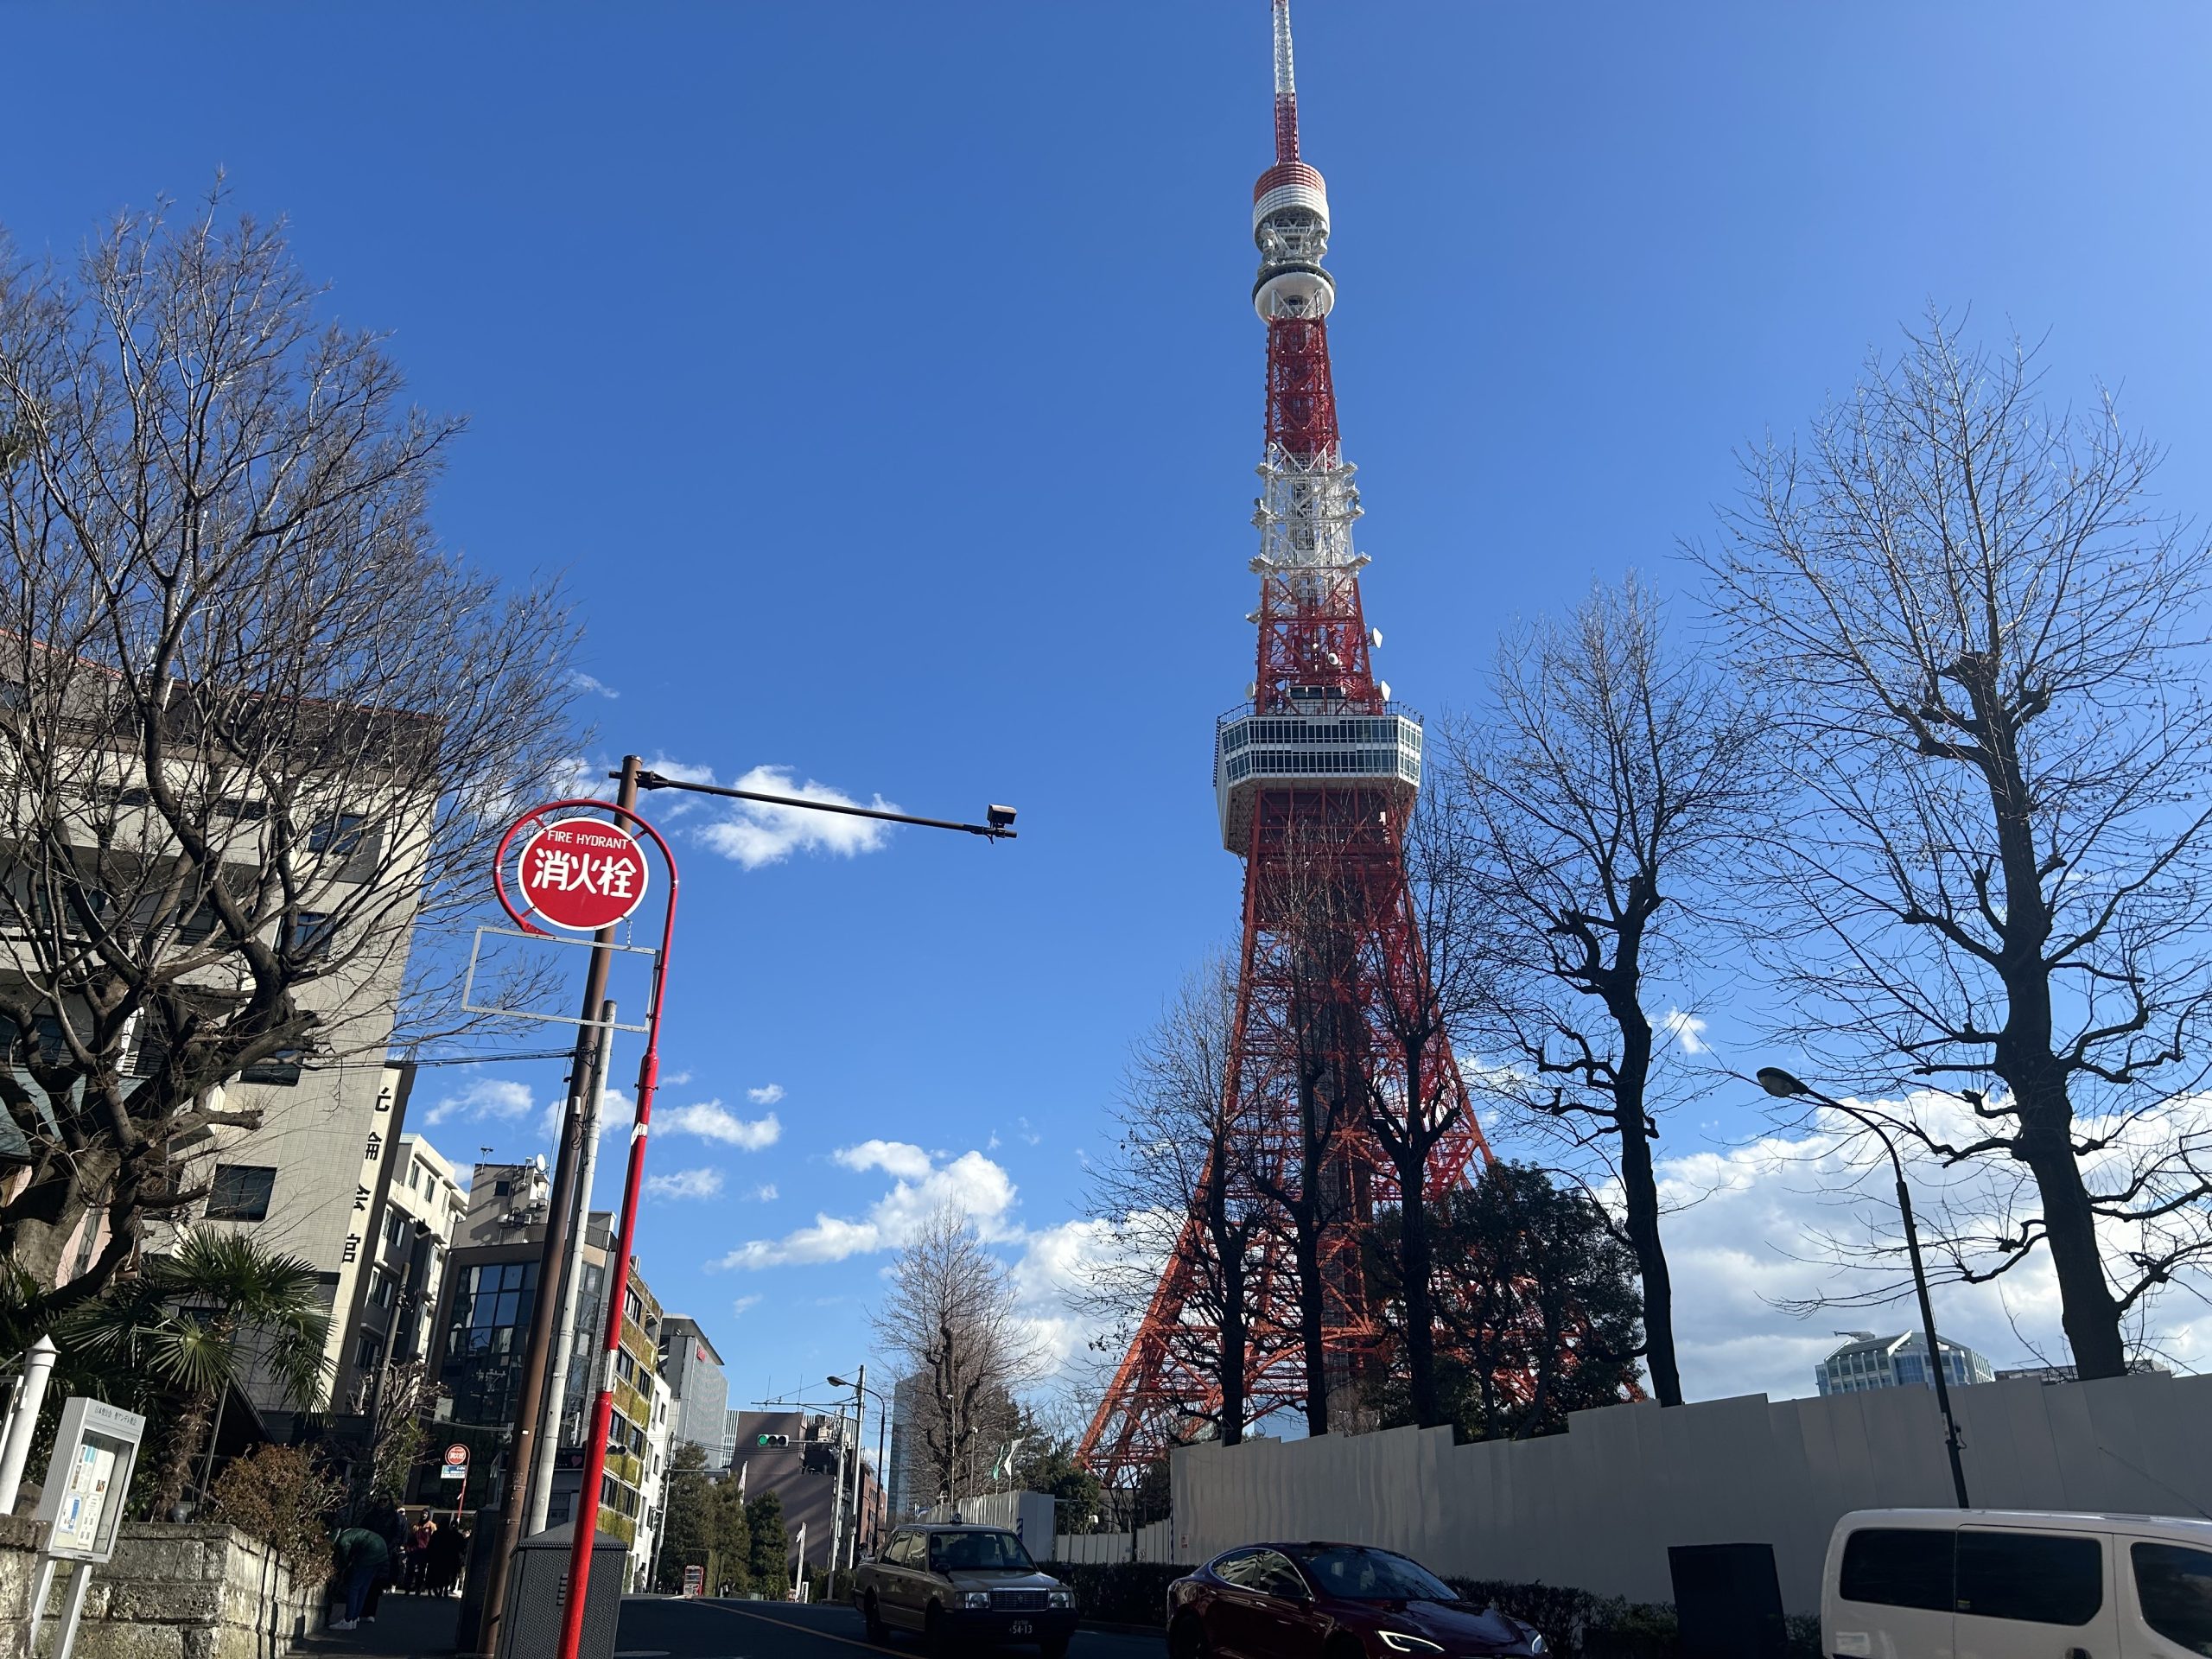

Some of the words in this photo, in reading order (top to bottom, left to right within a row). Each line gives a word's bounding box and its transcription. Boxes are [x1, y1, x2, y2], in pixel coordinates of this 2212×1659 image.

[547, 830, 573, 844] FIRE
[575, 834, 629, 850] HYDRANT
[531, 848, 638, 899] 消火栓
[1013, 1624, 1033, 1634] 54-13
